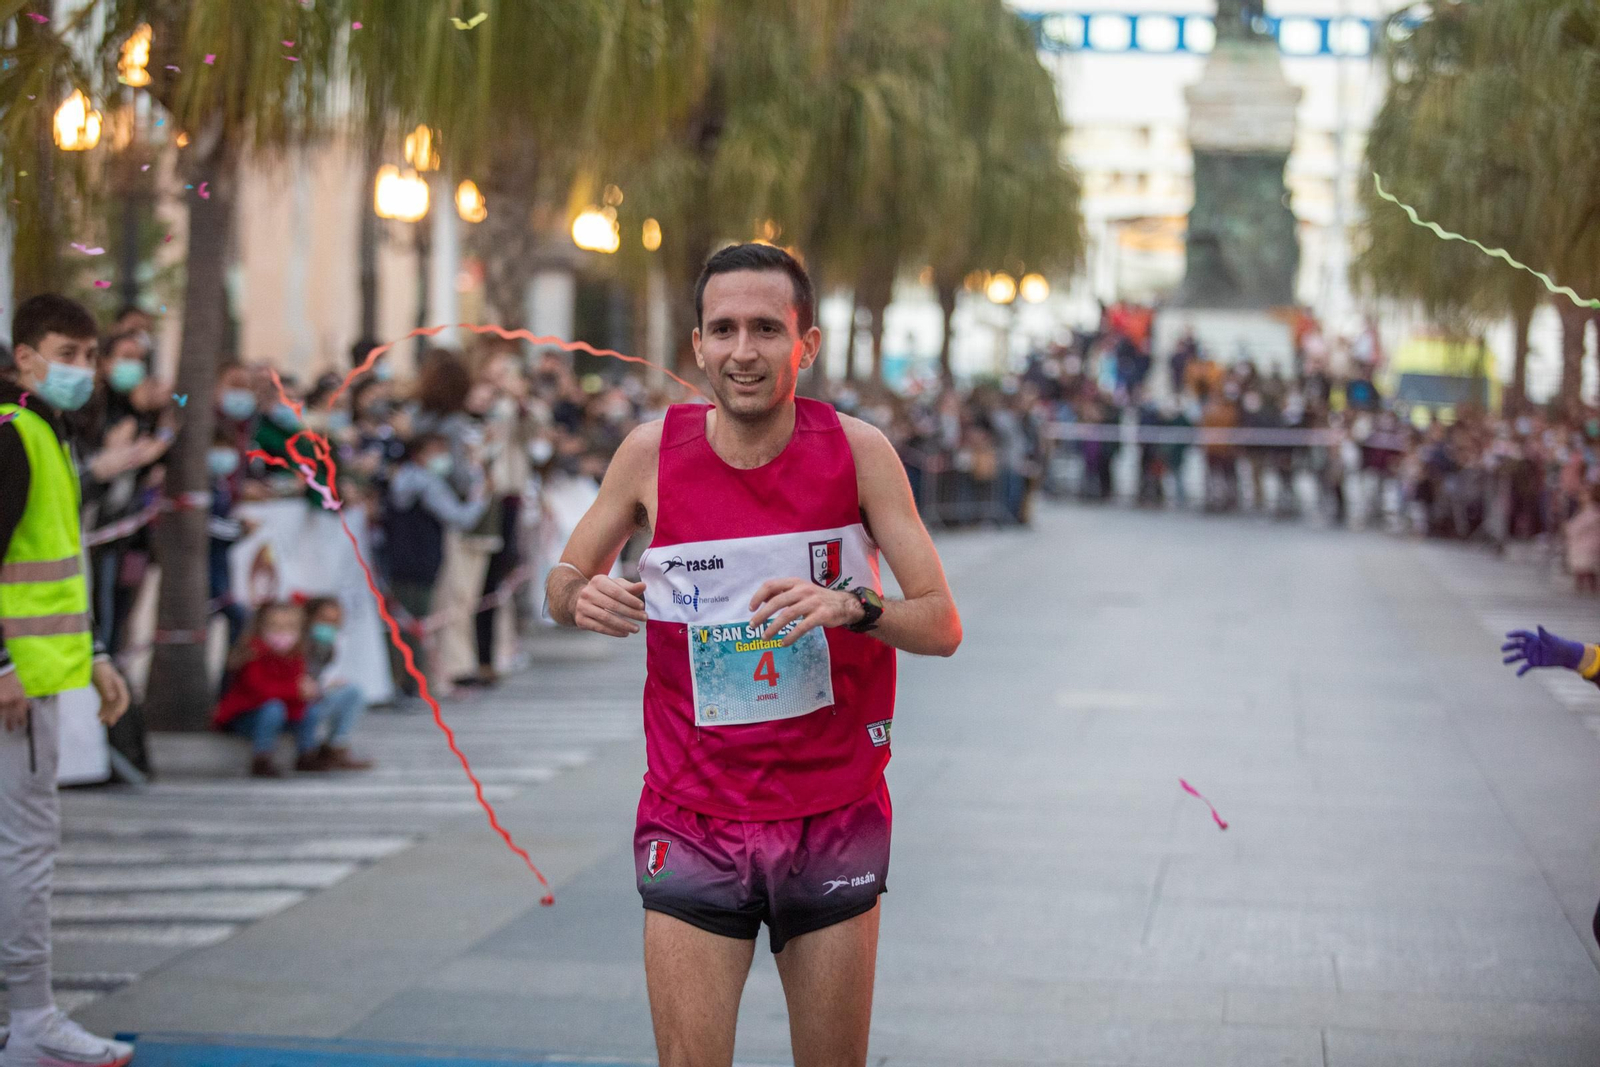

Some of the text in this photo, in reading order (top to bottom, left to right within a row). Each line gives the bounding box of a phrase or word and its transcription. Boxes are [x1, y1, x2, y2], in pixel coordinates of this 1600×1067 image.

[686, 555, 724, 572] rasán
[699, 596, 730, 604] herakles
[700, 629, 708, 643] V
[712, 627, 742, 642] SAN
[735, 639, 784, 653] Gaditana
[753, 651, 780, 687] 4
[756, 693, 779, 701] JORGE
[851, 871, 876, 887] rasán
